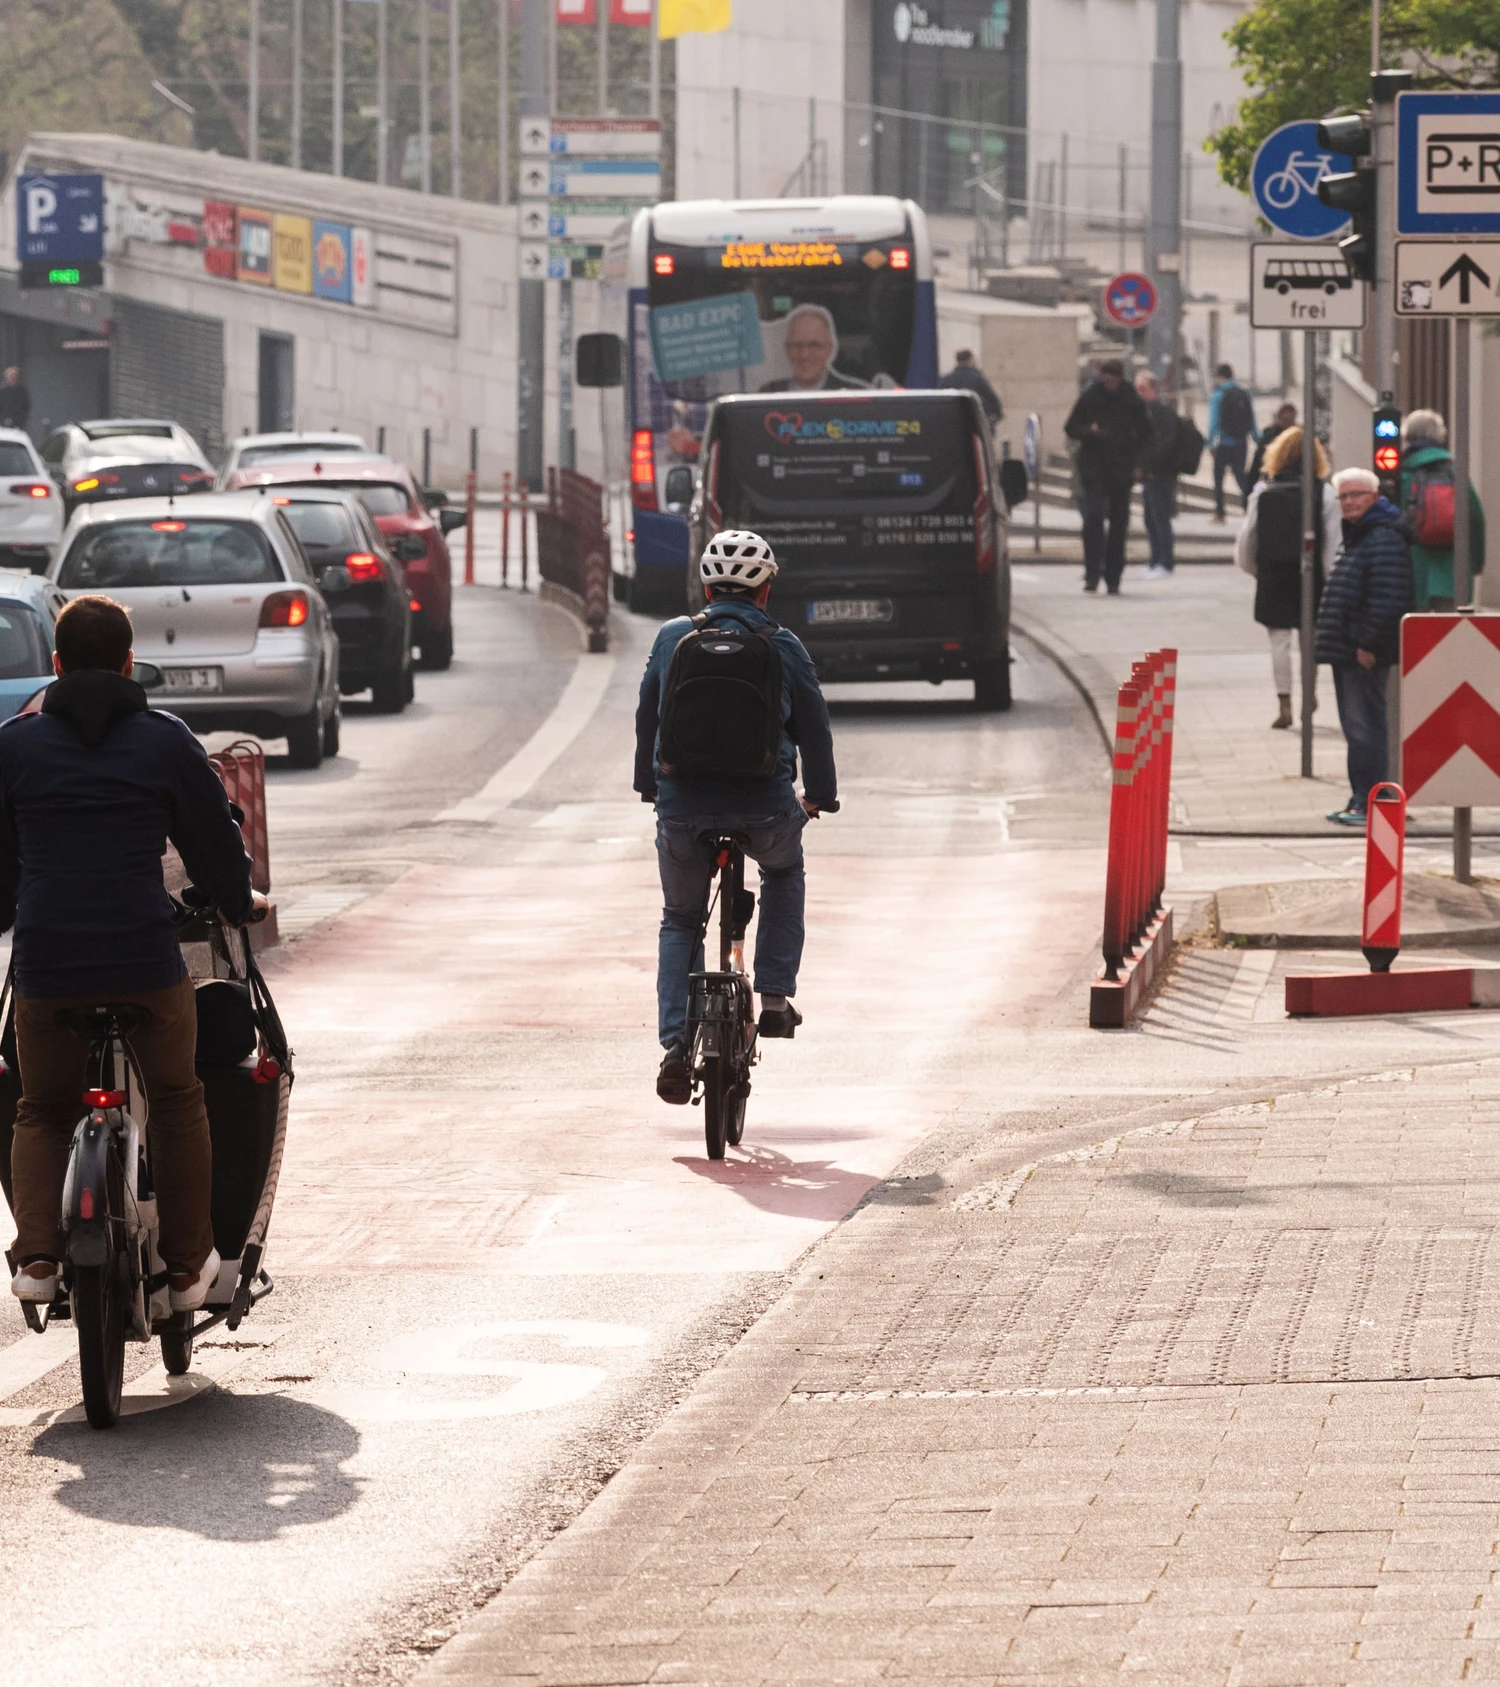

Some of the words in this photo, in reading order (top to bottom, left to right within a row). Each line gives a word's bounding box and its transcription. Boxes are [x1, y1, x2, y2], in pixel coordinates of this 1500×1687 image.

[1427, 144, 1500, 183] P+R
[27, 188, 58, 233] P
[1291, 301, 1327, 319] frei
